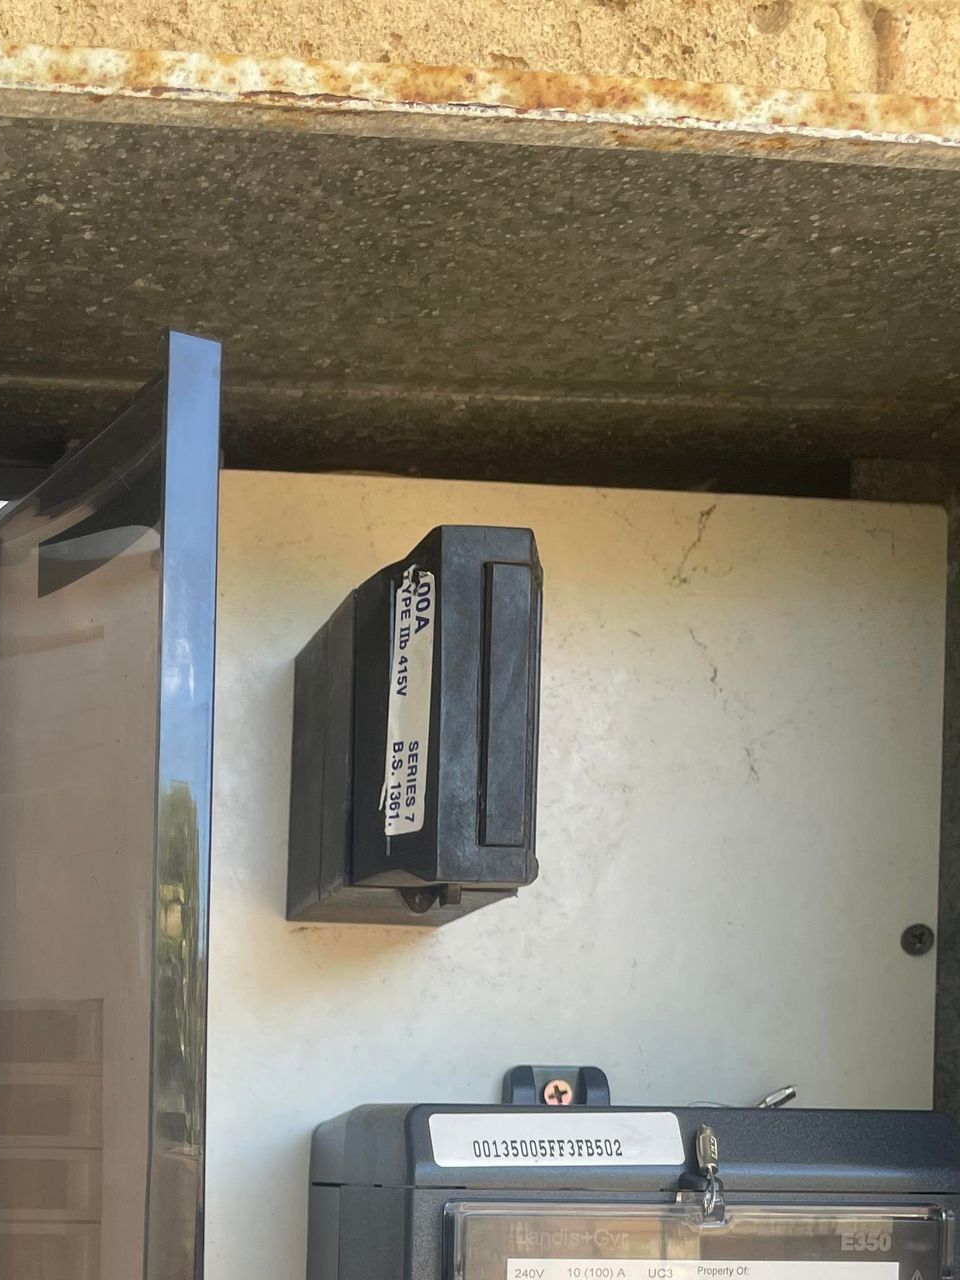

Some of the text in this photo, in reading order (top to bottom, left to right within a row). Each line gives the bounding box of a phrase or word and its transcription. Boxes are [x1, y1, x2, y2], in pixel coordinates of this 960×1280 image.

[400, 571, 412, 621] TYPE
[415, 615, 429, 634] A
[396, 656, 408, 696] 415V
[391, 741, 404, 778] B.S.
[405, 741, 419, 823] SERIES 7
[472, 1138, 624, 1159] 00135005FF3FB502
[840, 1232, 892, 1251] E350
[514, 1267, 673, 1280] 240V 10 (100) A UC3
[697, 1266, 750, 1277] Property Of:
